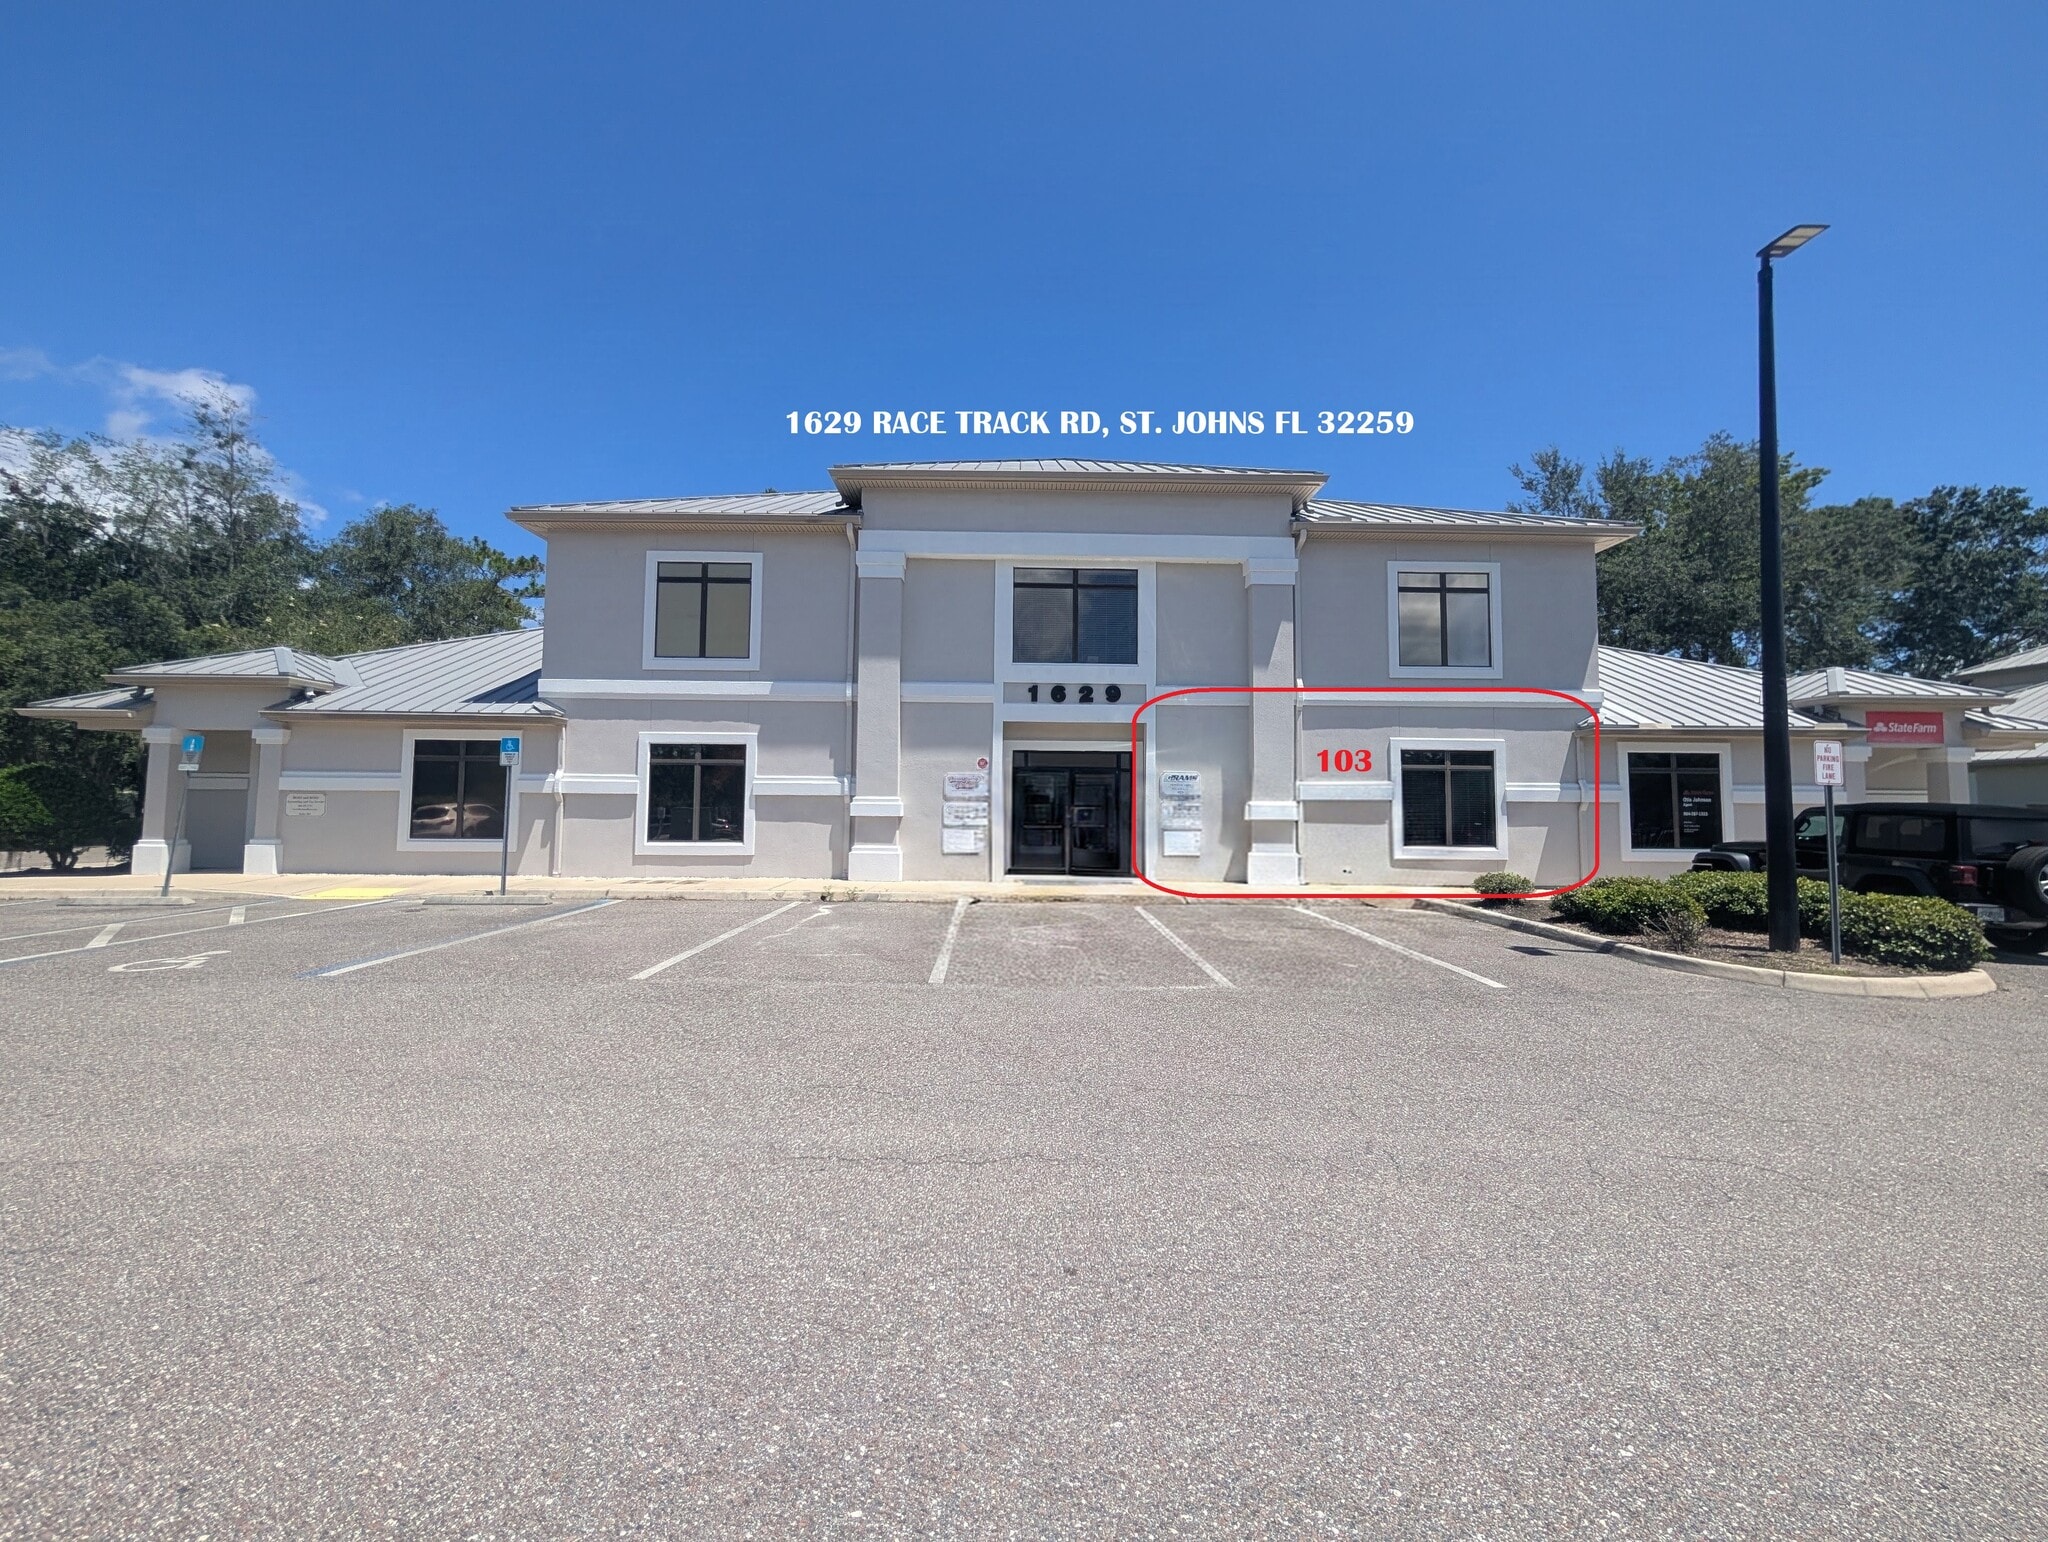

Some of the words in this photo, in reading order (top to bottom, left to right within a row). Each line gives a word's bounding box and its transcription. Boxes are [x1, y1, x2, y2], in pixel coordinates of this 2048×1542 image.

[1028, 684, 1122, 703] 1629
[1823, 746, 1832, 754] NO
[1816, 754, 1840, 763] PARKING
[1822, 763, 1835, 771] FIRE
[1821, 772, 1836, 780] LANE
